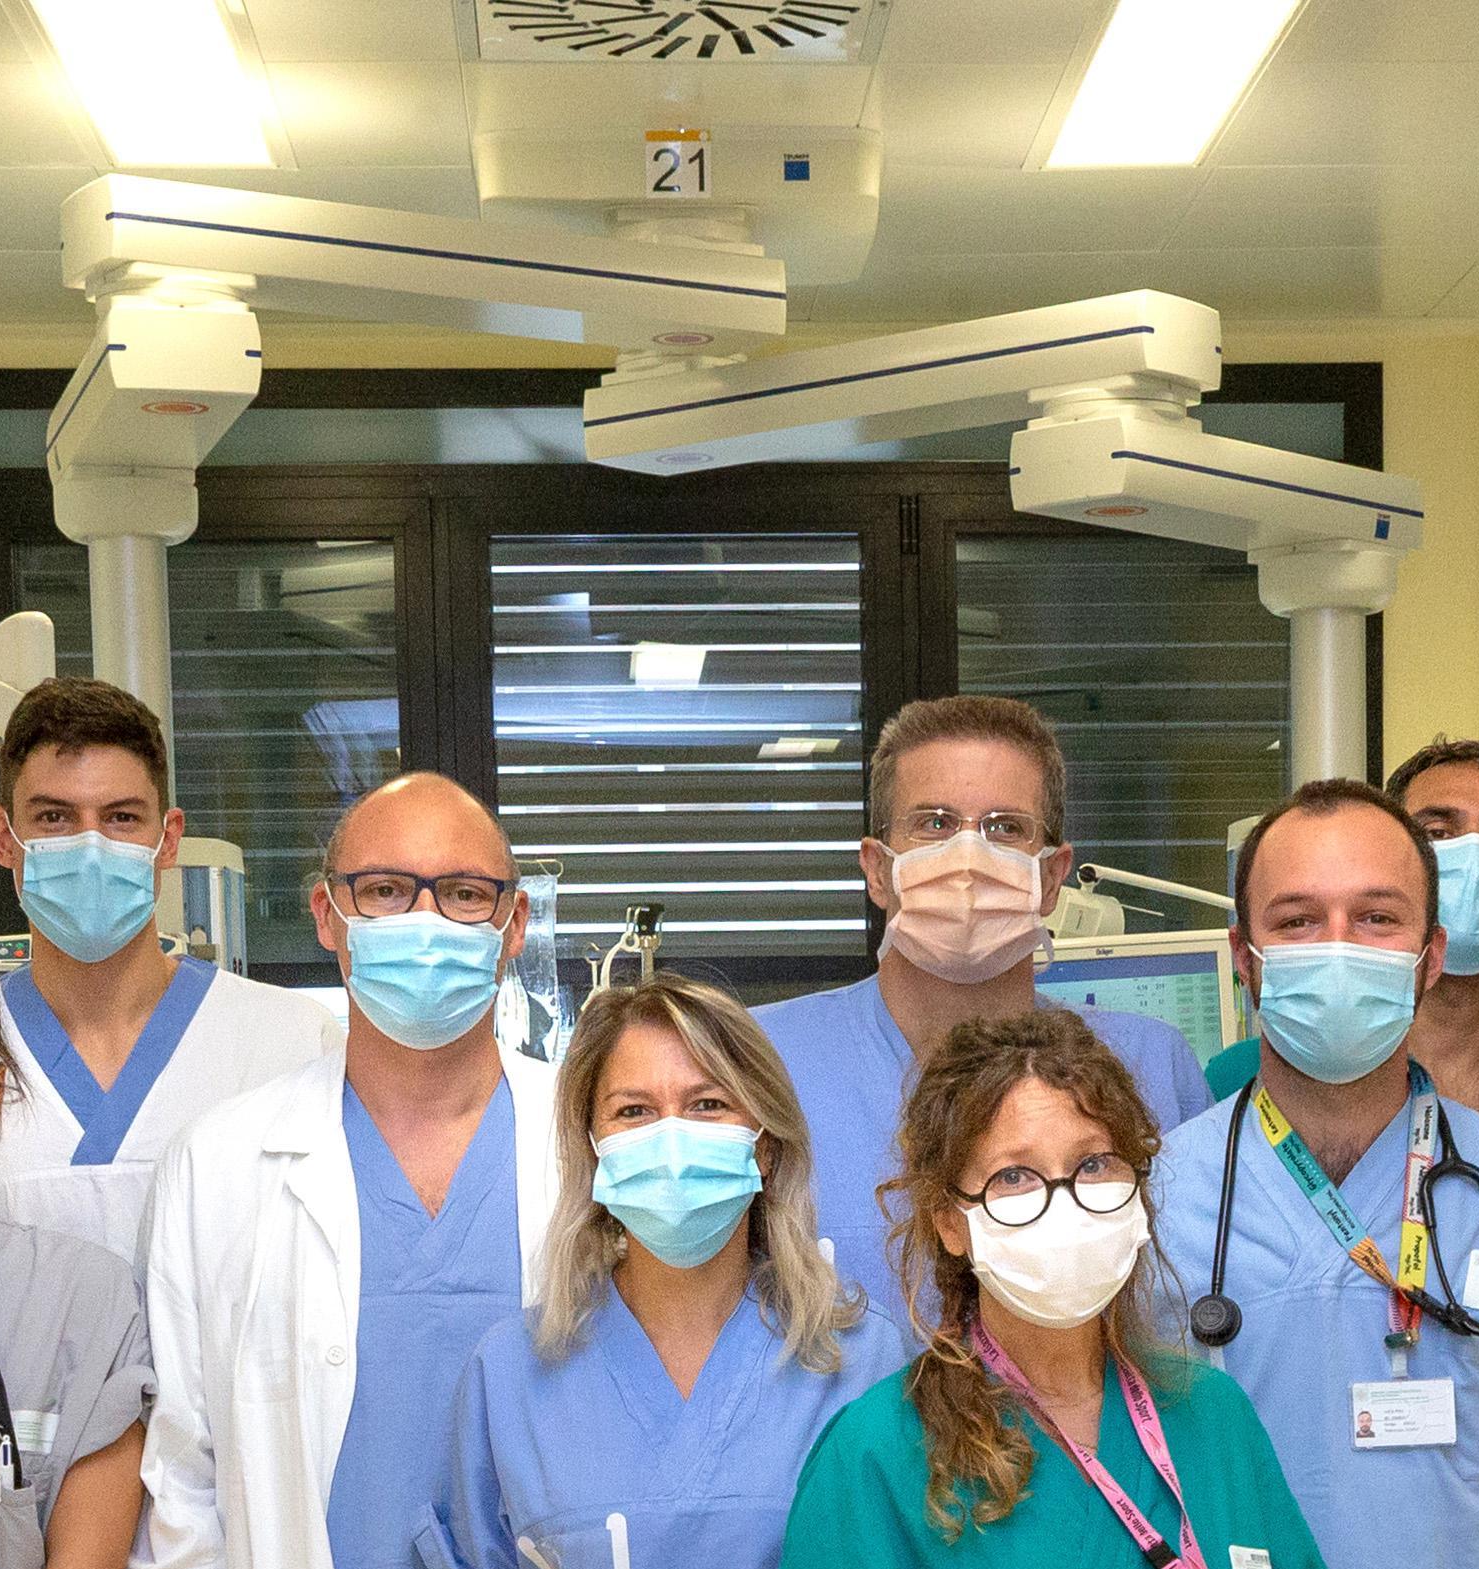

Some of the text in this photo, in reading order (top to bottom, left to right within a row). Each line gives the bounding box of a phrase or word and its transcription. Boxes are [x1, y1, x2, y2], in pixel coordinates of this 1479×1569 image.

[653, 148, 705, 192] 21
[1423, 1105, 1433, 1140] Naloxone
[1326, 1209, 1354, 1243] Fentanyl
[1413, 1235, 1423, 1271] Propofol
[1134, 1400, 1153, 1423] Sport
[1116, 1498, 1135, 1521] Sport
